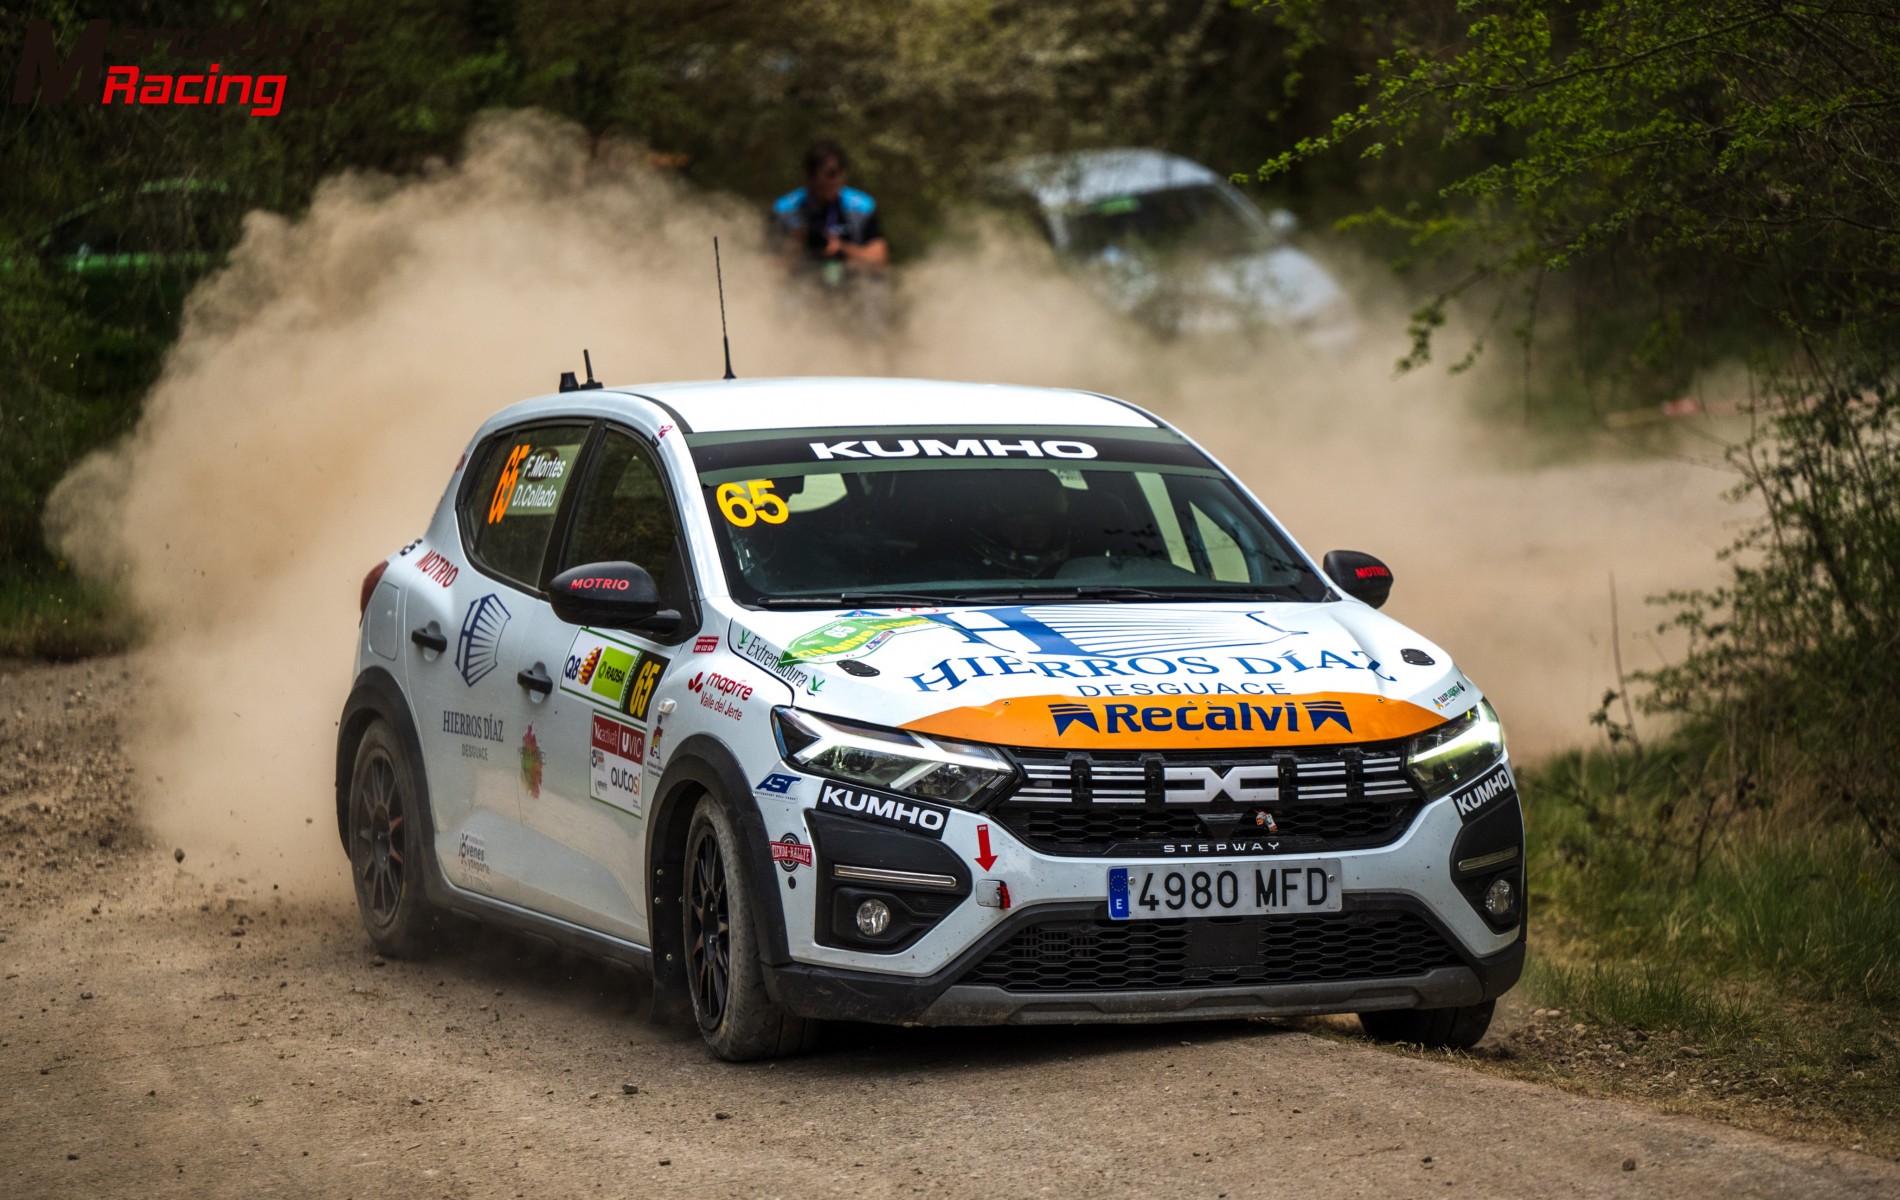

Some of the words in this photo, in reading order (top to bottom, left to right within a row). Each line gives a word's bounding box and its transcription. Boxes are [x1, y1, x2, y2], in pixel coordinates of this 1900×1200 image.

[811, 439, 1098, 460] KUMHO
[523, 455, 566, 478] F.Montes
[489, 444, 531, 524] 65
[512, 484, 556, 507] D.Collado
[716, 480, 790, 528] 65
[415, 549, 459, 588] MOTRIO
[570, 578, 629, 590] MOTRIO
[824, 624, 859, 639] 65
[565, 655, 581, 680] Q8
[605, 666, 626, 684] RADSA
[746, 636, 808, 688] Extremadura
[904, 655, 1222, 692] HIERROS
[1228, 650, 1397, 682] DÍAZ
[629, 660, 660, 717] 65
[706, 672, 753, 700] mapfre
[1076, 683, 1292, 697] DESGUACE
[700, 691, 715, 709] Valle
[714, 698, 726, 713] del
[725, 702, 743, 721] Jerte
[1104, 701, 1300, 734] Recalvi
[443, 710, 483, 738] HIERROS
[484, 713, 504, 742] DÍAZ
[461, 744, 489, 761] DESGUACE
[622, 732, 642, 758] UVIC
[611, 767, 641, 797] autosi
[1456, 769, 1510, 816] KUMHO
[822, 785, 945, 831] KUMHO
[1164, 842, 1280, 852] STEPWAY
[1138, 870, 1239, 911] 4980
[1254, 867, 1328, 908] MFD
[1115, 898, 1123, 910] E
